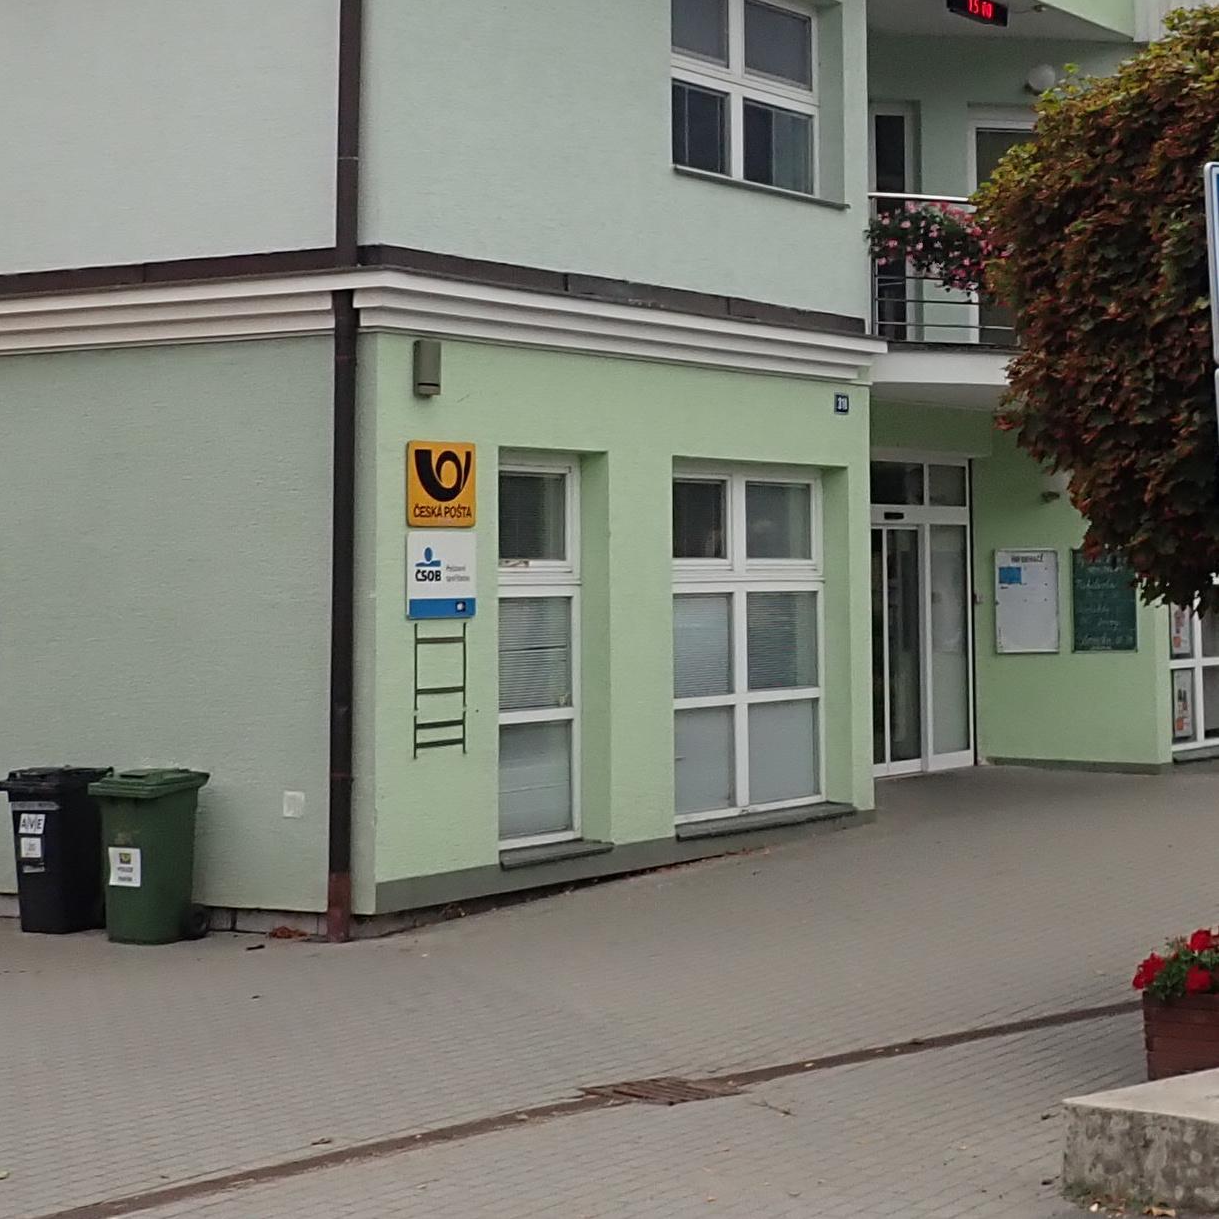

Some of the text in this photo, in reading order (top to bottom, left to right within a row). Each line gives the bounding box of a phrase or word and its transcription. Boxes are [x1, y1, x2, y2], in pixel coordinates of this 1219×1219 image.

[414, 503, 472, 518] ČESKÁ POŠTA
[415, 569, 442, 582] ČSOB
